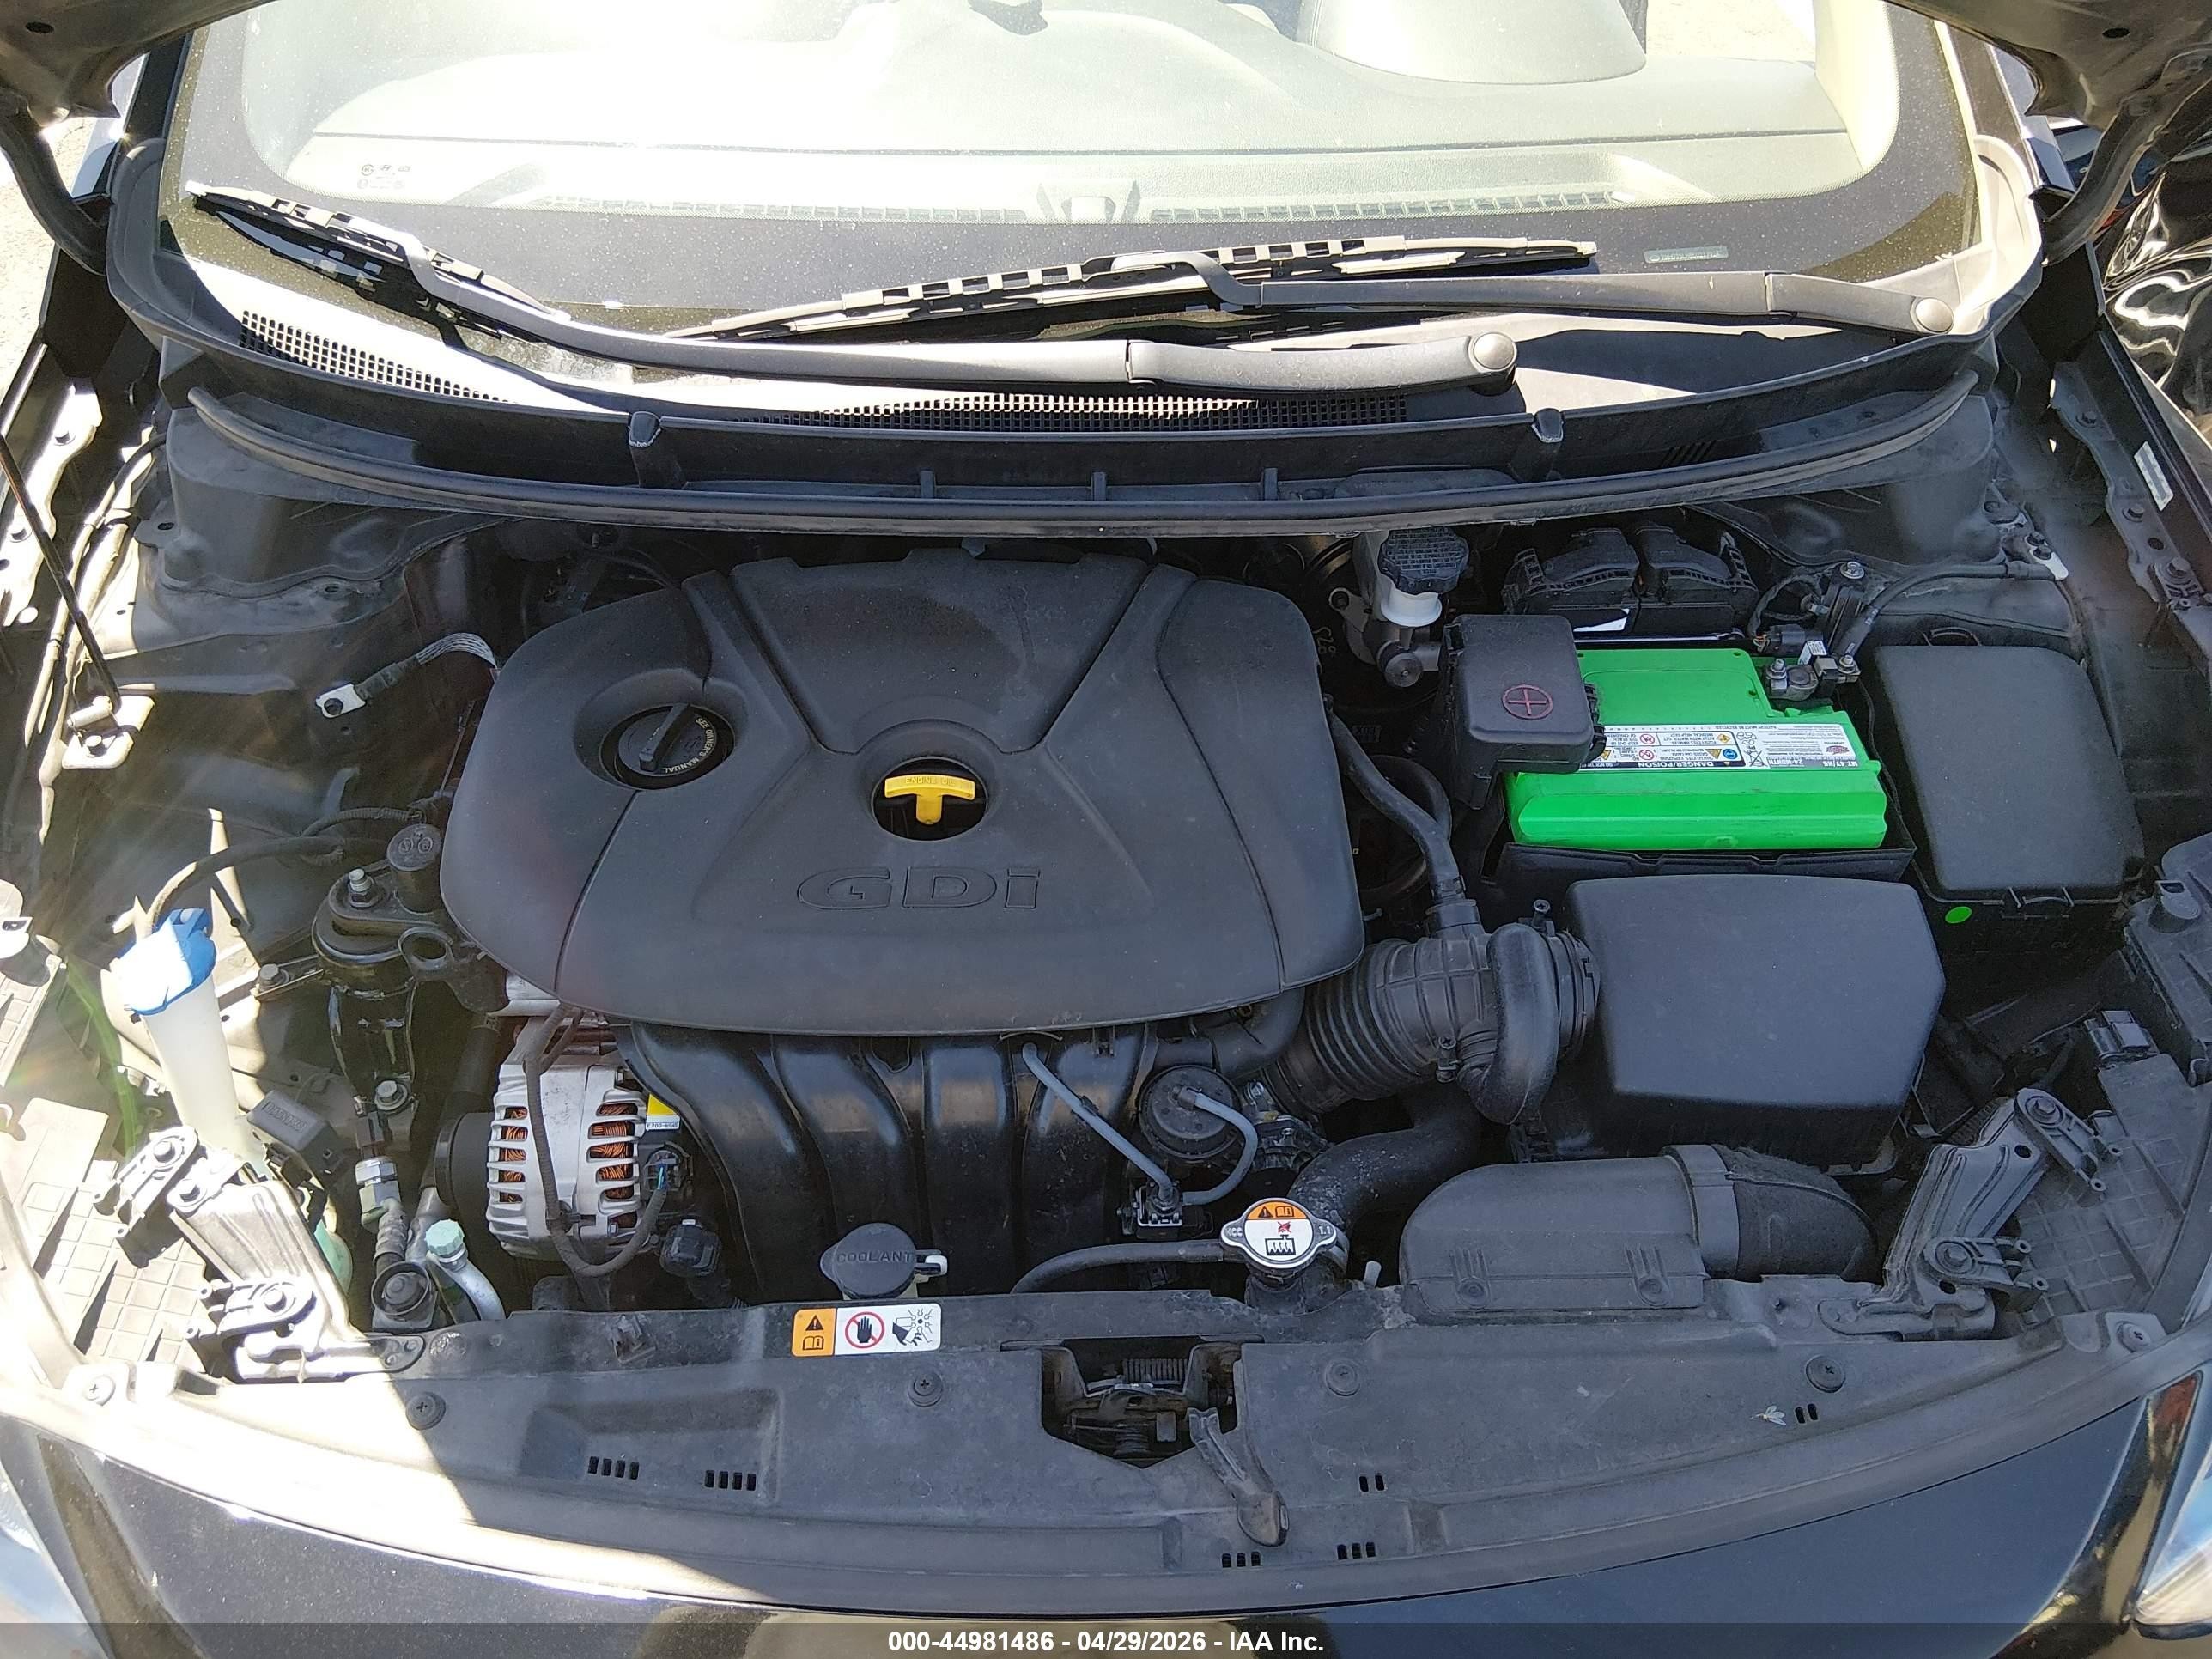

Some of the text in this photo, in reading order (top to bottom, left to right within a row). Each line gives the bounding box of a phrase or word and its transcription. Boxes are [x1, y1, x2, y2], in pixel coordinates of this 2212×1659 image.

[663, 717, 714, 773] SEE OWNER'S MANUAL
[905, 775, 955, 786] ENGINE OIL
[797, 866, 1041, 910] GDi
[836, 1249, 915, 1263] COOLANT
